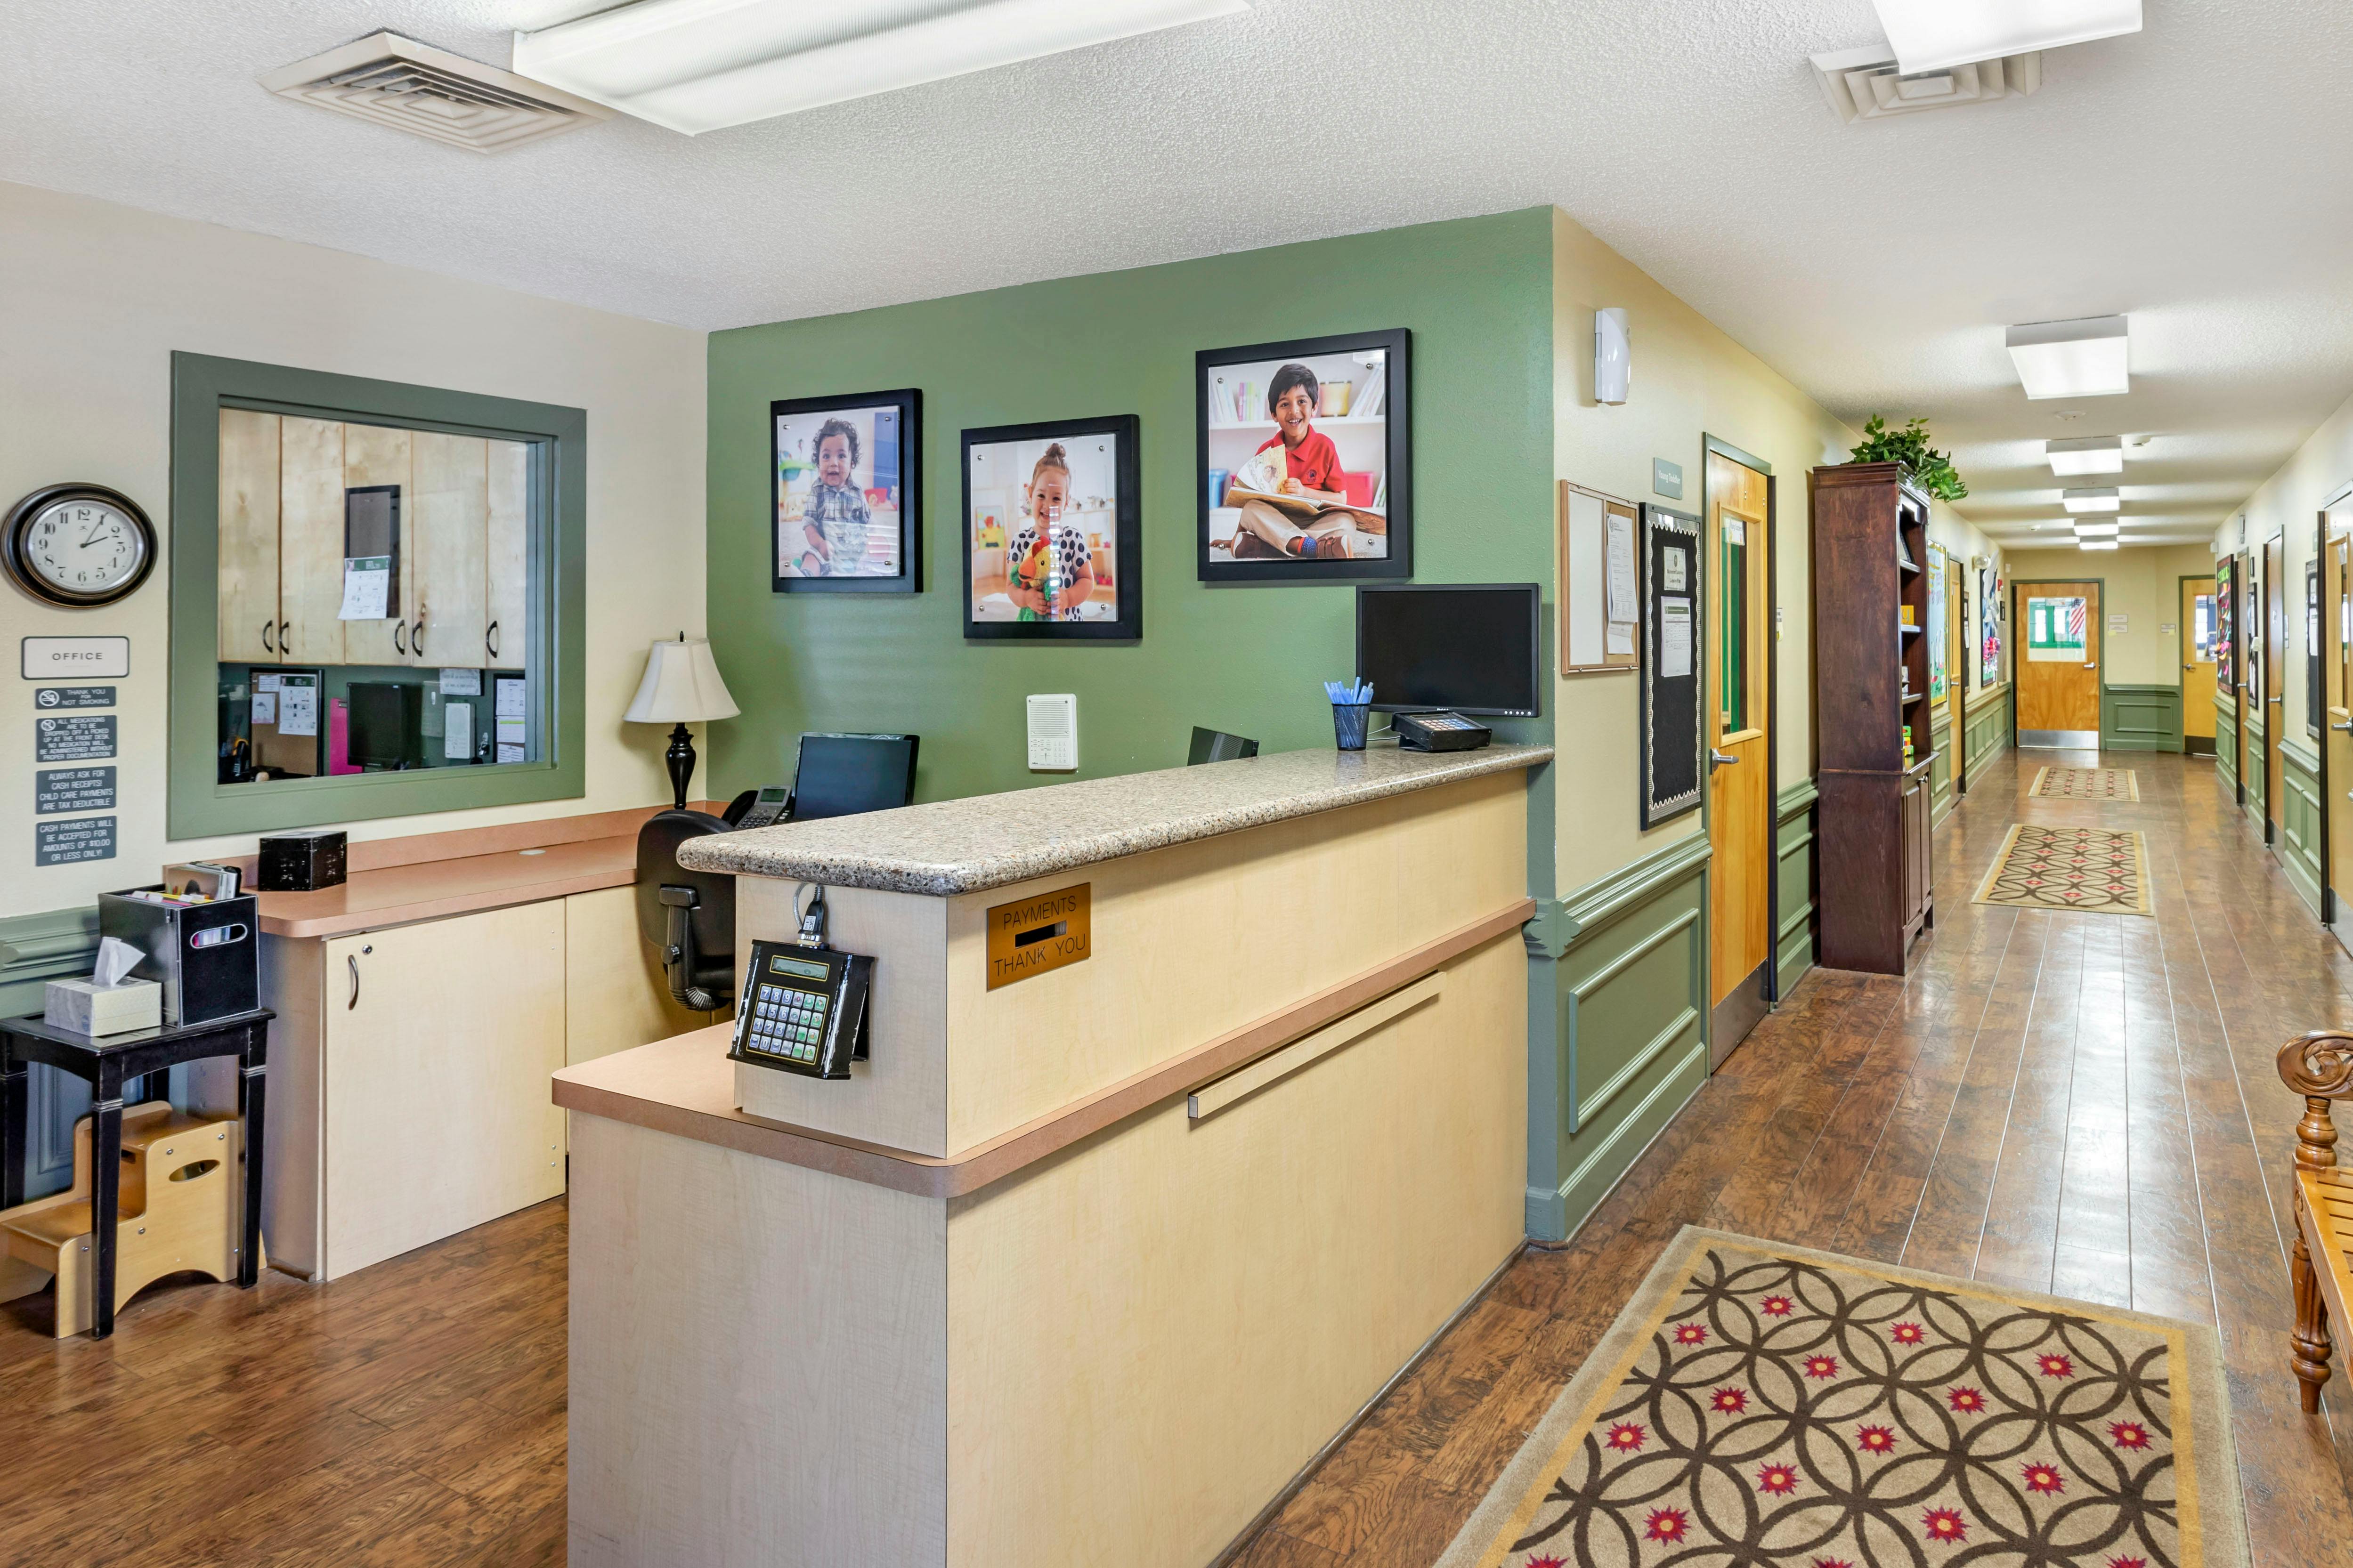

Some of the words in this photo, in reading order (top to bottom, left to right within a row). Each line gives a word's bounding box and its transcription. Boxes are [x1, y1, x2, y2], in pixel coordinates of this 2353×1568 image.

[1658, 469, 1669, 483] Young
[59, 512, 68, 524] 11
[78, 509, 90, 521] 12
[44, 523, 56, 534] 10
[111, 526, 120, 538] 2
[39, 538, 48, 550] 9
[116, 542, 125, 554] 3
[45, 554, 54, 566] 8
[107, 557, 116, 568] 4
[57, 566, 66, 578] 7
[78, 571, 87, 582] 6
[96, 567, 105, 579] 5
[49, 772, 75, 780] ALWAYS
[72, 780, 102, 788] RECEIPTS!
[80, 788, 113, 797] PAYMENTS
[73, 798, 110, 808] DEDUCTIBLE
[60, 821, 95, 831] PAYMENTS
[58, 831, 91, 841] ACCEPTED
[42, 842, 75, 852] AMOUNTS
[89, 839, 111, 847] $10.00
[64, 852, 81, 860] LESS
[1004, 895, 1076, 930] PAYMENTS
[994, 946, 1047, 977] THANK
[1055, 933, 1086, 957] YOU
[774, 992, 779, 1000] 8
[785, 994, 790, 1002] 9
[767, 1023, 772, 1031] 2
[778, 1026, 782, 1034] 3
[763, 1039, 768, 1048] 0
